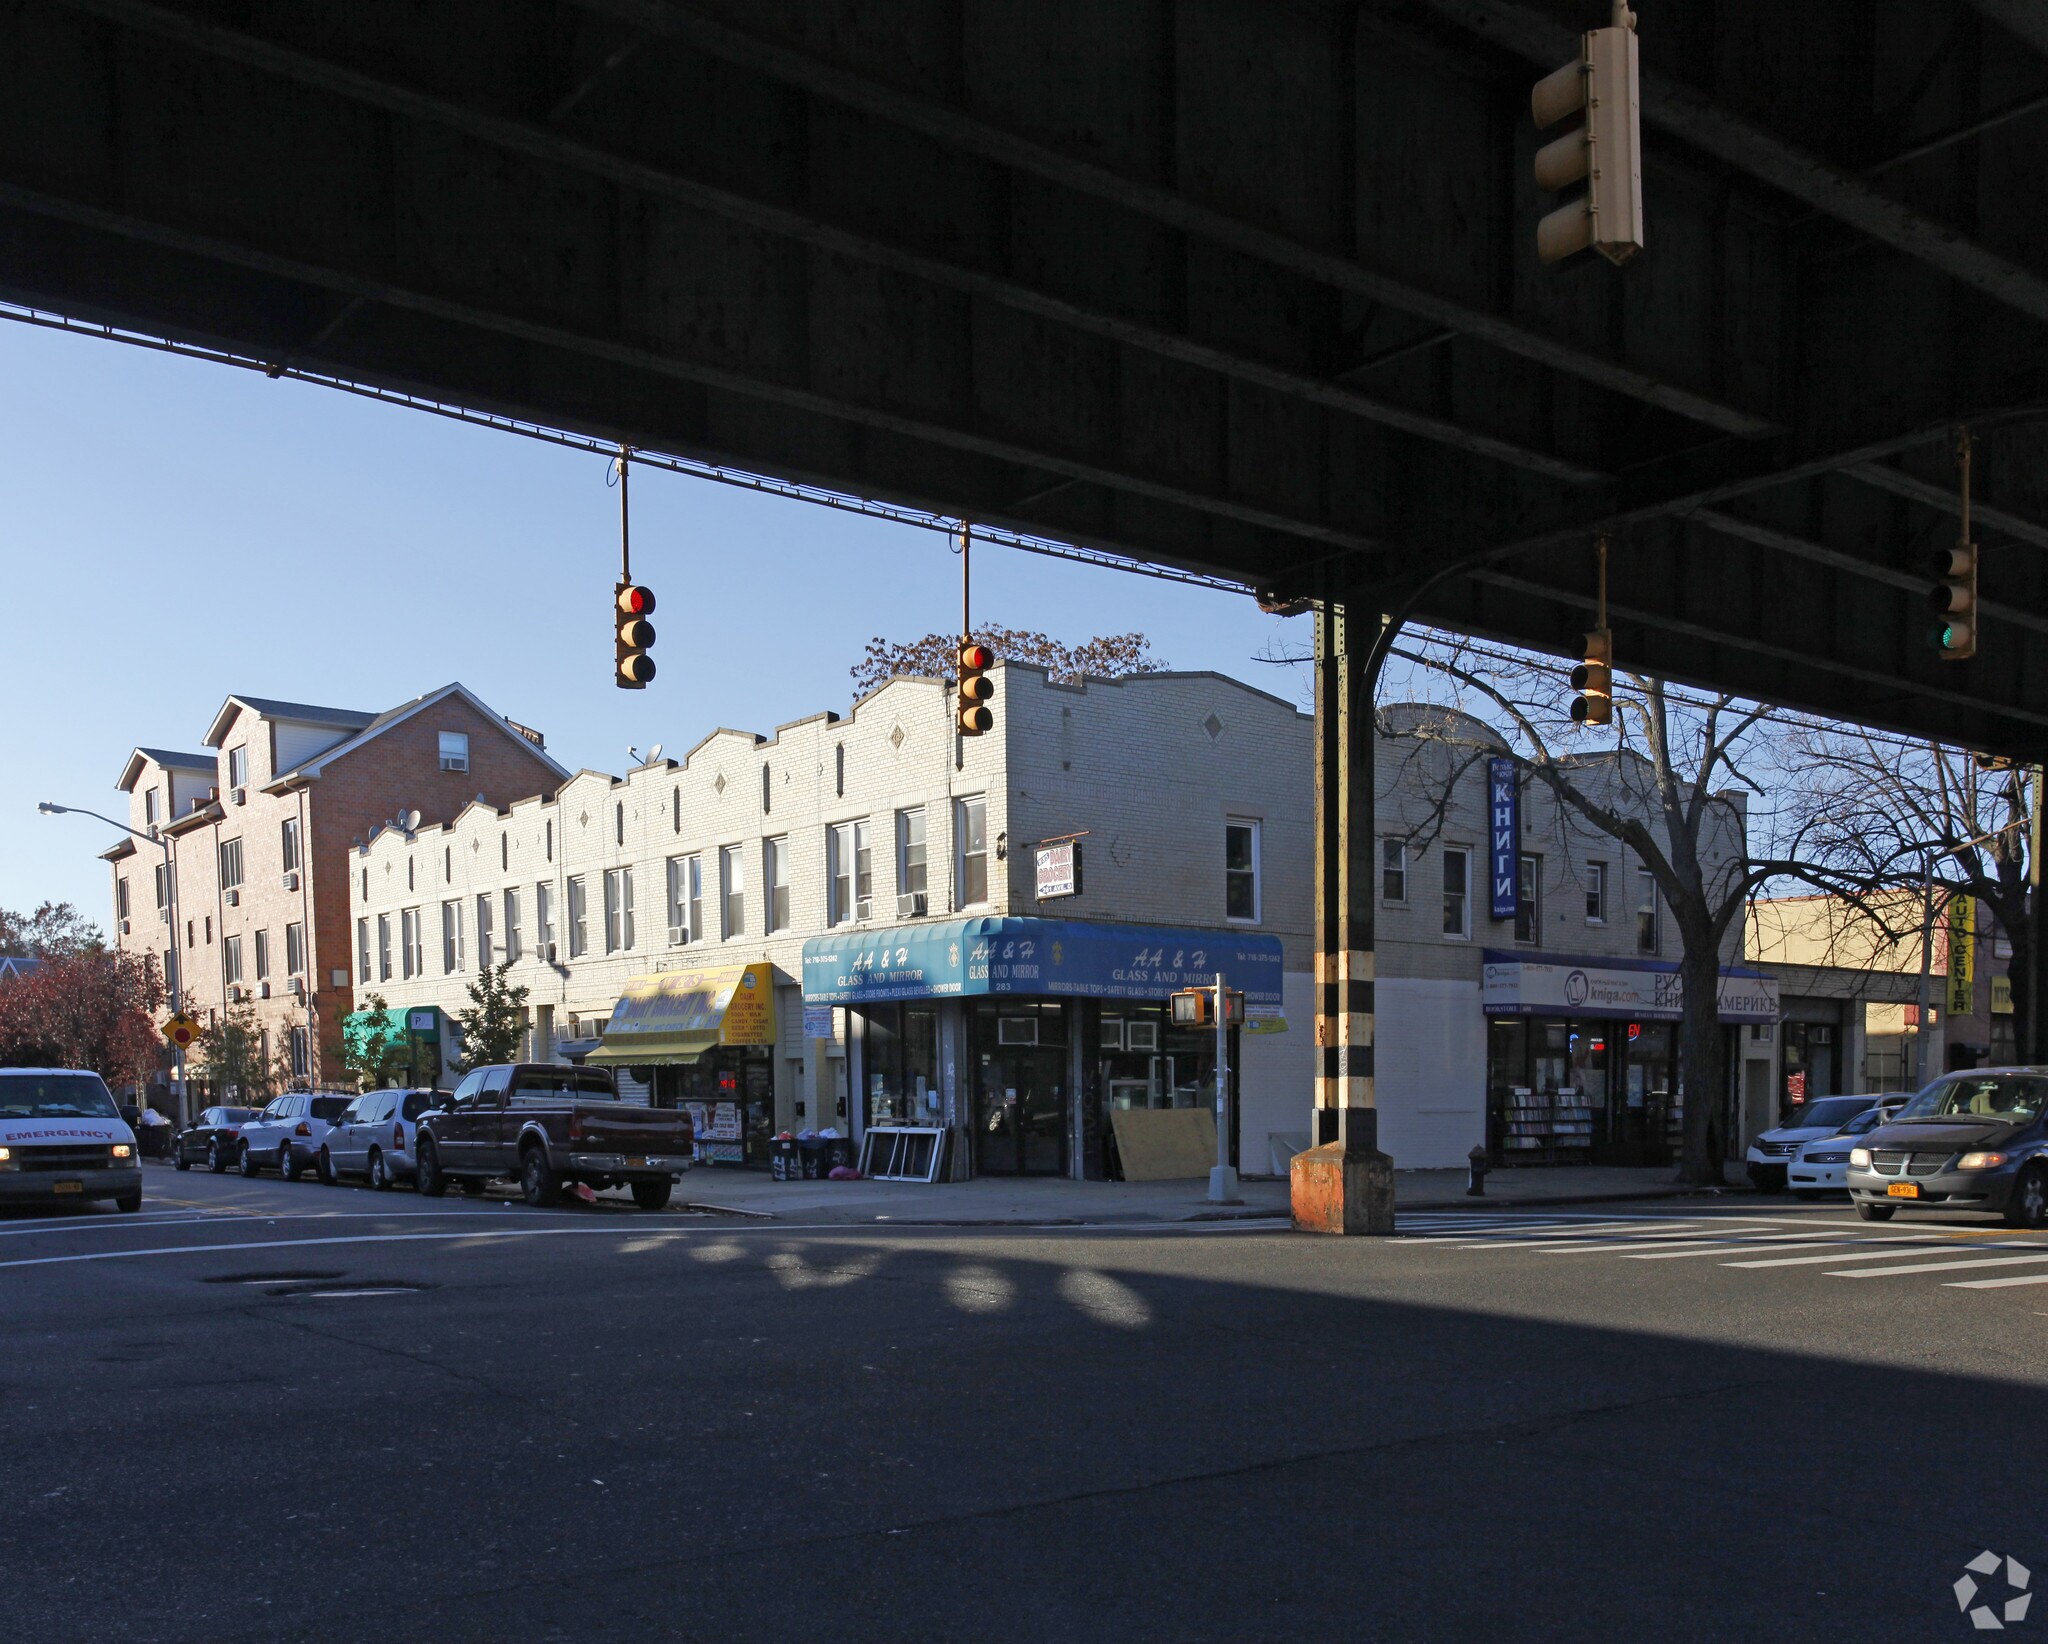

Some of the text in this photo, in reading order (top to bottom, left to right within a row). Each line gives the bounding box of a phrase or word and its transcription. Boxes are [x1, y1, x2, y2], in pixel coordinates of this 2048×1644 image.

[1495, 782, 1512, 897] КНИГИ
[1050, 846, 1073, 865] DAIRY
[1038, 863, 1073, 884] GROCERY
[881, 949, 890, 968] &
[896, 947, 909, 967] H
[1003, 941, 1014, 959] &
[1019, 941, 1036, 959] H
[1173, 950, 1184, 968] &
[1192, 950, 1208, 969] H
[837, 969, 923, 987] GLASS AND MIRROR
[969, 965, 1039, 979] GLASS AND MIRROR
[1112, 968, 1217, 985] GLASS AND MIRRO
[1953, 945, 1967, 1011] CENTER
[865, 989, 876, 998] STORE
[876, 988, 890, 997] FRONTS
[902, 986, 914, 996] GLASS
[933, 984, 949, 993] SHOWER
[949, 983, 962, 992] DOOR
[996, 983, 1011, 991] 283
[1090, 983, 1103, 993] TOPS
[1107, 984, 1126, 995] SAFETY
[1127, 986, 1145, 996] GLASS
[1148, 987, 1162, 996] STORE
[1654, 974, 1682, 991] РУС
[1245, 991, 1265, 1000] SHOWER
[1591, 987, 1640, 1004] kniga.com
[1654, 991, 1684, 1008] КНИ
[731, 1002, 754, 1010] GROCERY
[5, 1129, 113, 1141] EMERGENCY
